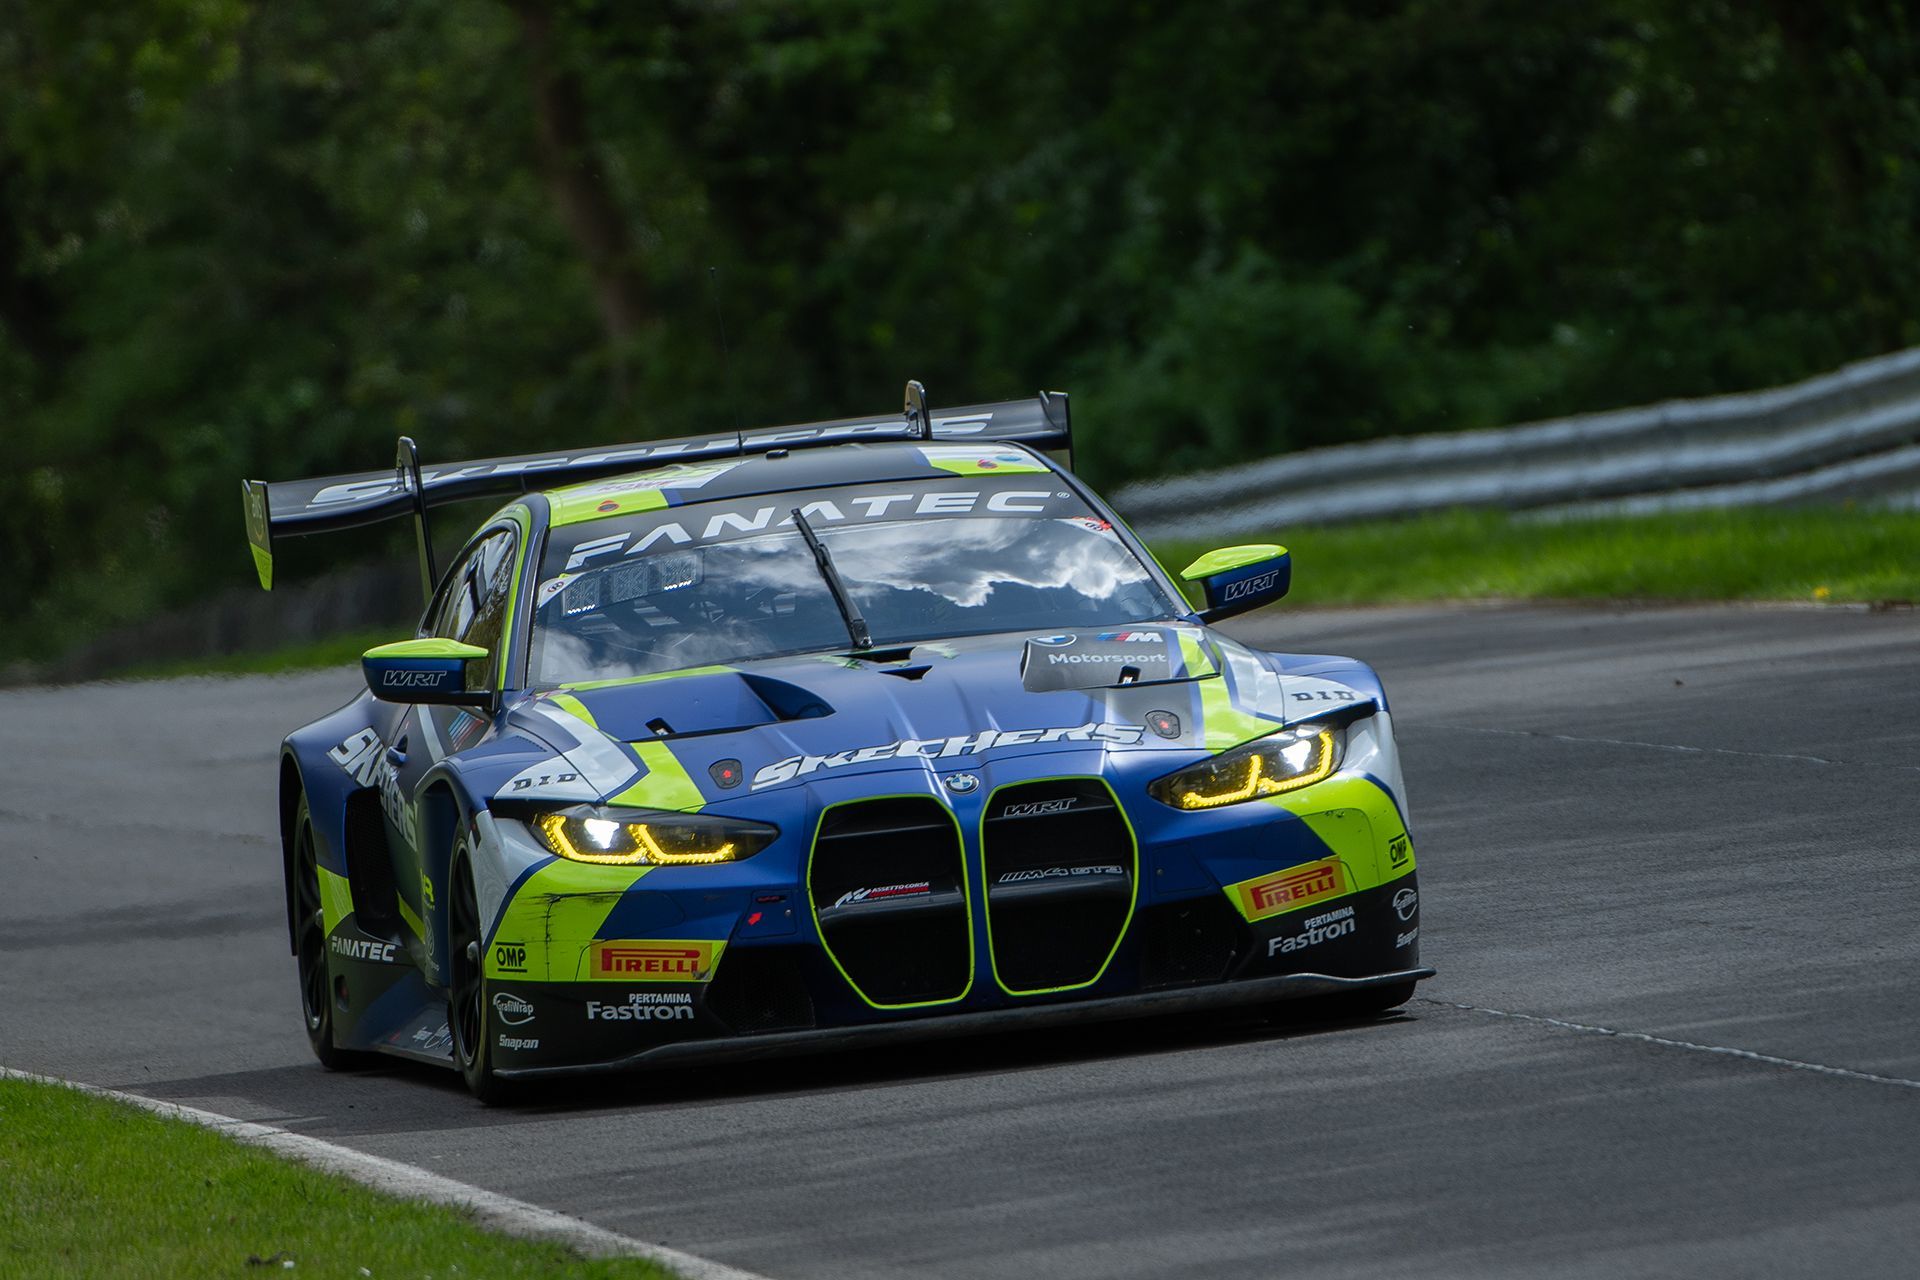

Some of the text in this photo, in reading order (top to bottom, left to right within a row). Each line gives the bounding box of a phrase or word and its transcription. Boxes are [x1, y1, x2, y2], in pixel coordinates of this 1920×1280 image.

[1224, 569, 1279, 601] WRT
[1048, 652, 1167, 665] Motorsport
[383, 670, 447, 687] WRT
[751, 721, 1146, 792] SKECHERS
[1004, 797, 1077, 817] WRT
[1250, 866, 1334, 911] PIRELLI
[1304, 906, 1355, 930] PERTAMINA
[331, 935, 396, 962] FANATEC
[1268, 918, 1356, 957] Fastron
[496, 946, 527, 968] OMP
[602, 948, 700, 973] PIRELLI
[629, 993, 692, 1003] PERTAMINA
[587, 1001, 694, 1020] Fastron
